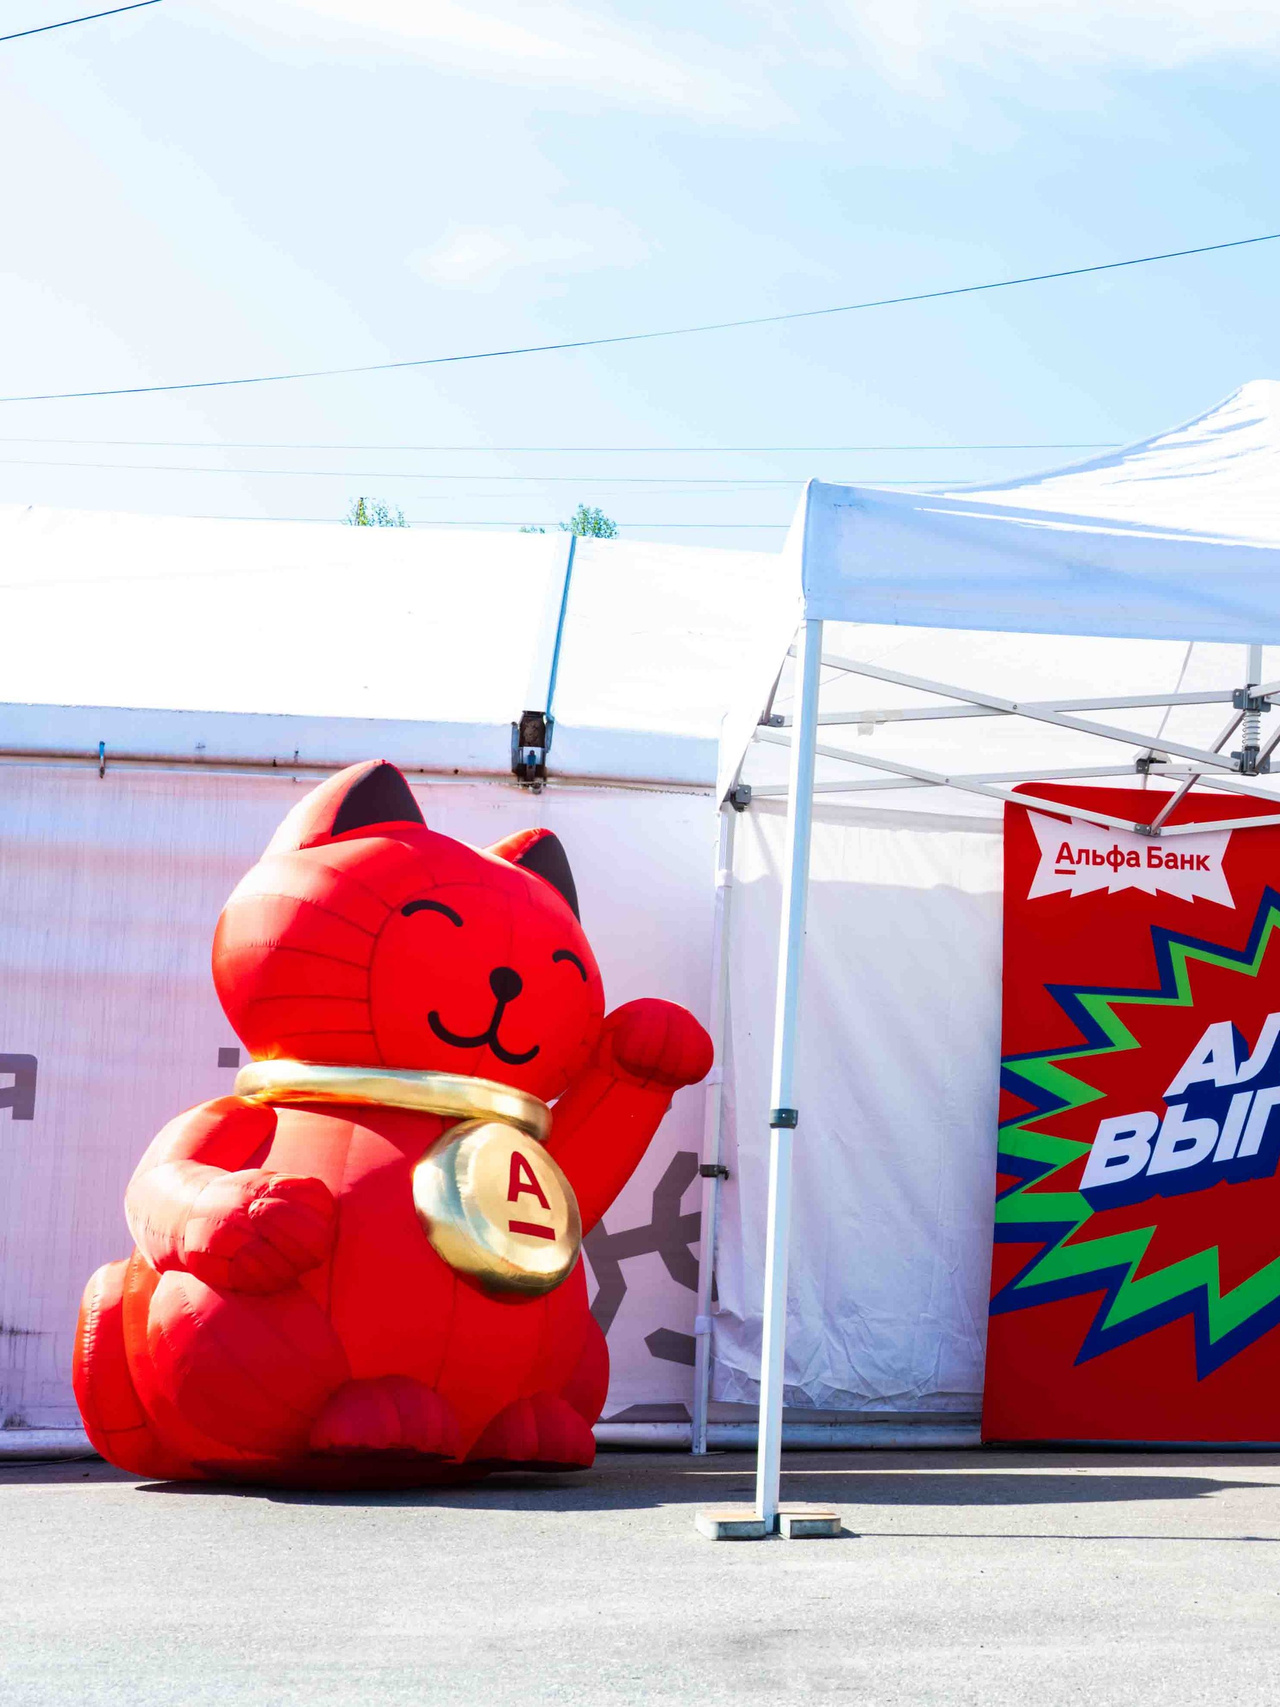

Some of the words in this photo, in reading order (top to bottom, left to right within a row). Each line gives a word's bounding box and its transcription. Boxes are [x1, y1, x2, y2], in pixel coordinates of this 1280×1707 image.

[1055, 841, 1140, 875] Альфа
[1147, 845, 1211, 871] Банк
[506, 1150, 552, 1211] А
